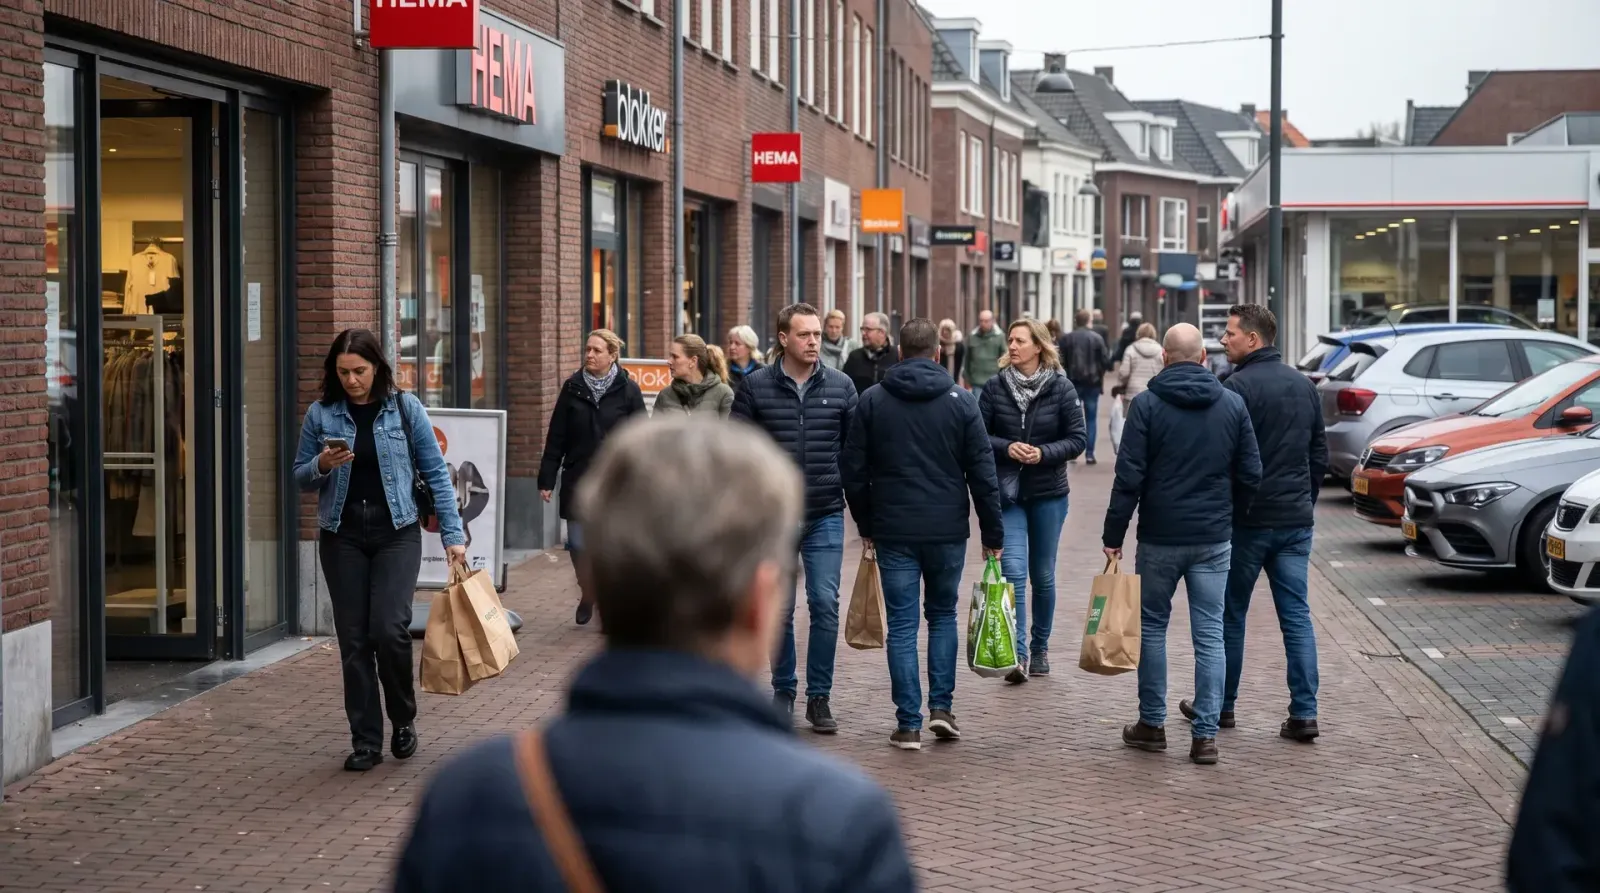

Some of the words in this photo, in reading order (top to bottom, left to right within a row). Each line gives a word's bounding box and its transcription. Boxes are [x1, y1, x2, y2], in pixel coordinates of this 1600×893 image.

[472, 24, 537, 125] HEMA
[616, 79, 667, 153] blokker
[754, 151, 799, 165] HEMA
